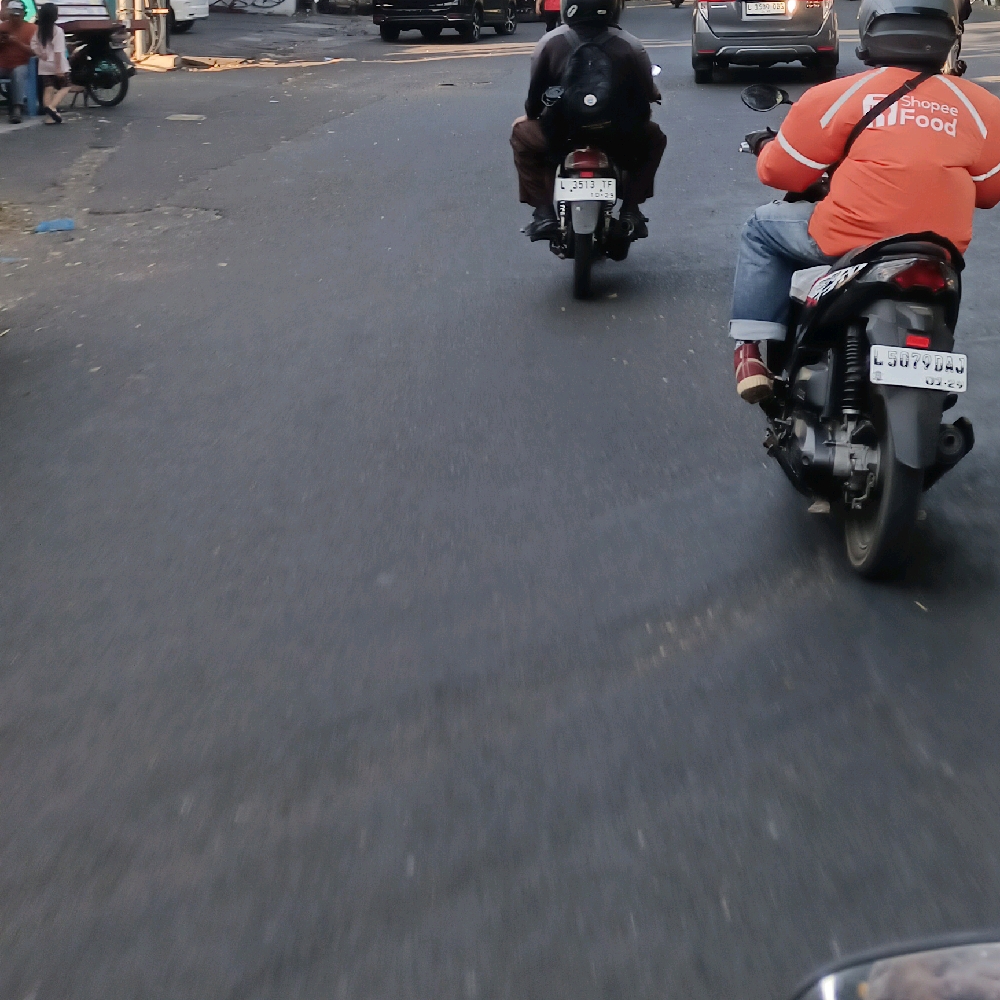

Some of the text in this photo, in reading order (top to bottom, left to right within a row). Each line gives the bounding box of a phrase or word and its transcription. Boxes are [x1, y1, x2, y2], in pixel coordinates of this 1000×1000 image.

[900, 94, 959, 117] Shopee
[900, 108, 958, 138] Food
[560, 181, 565, 190] L
[873, 348, 884, 366] L
